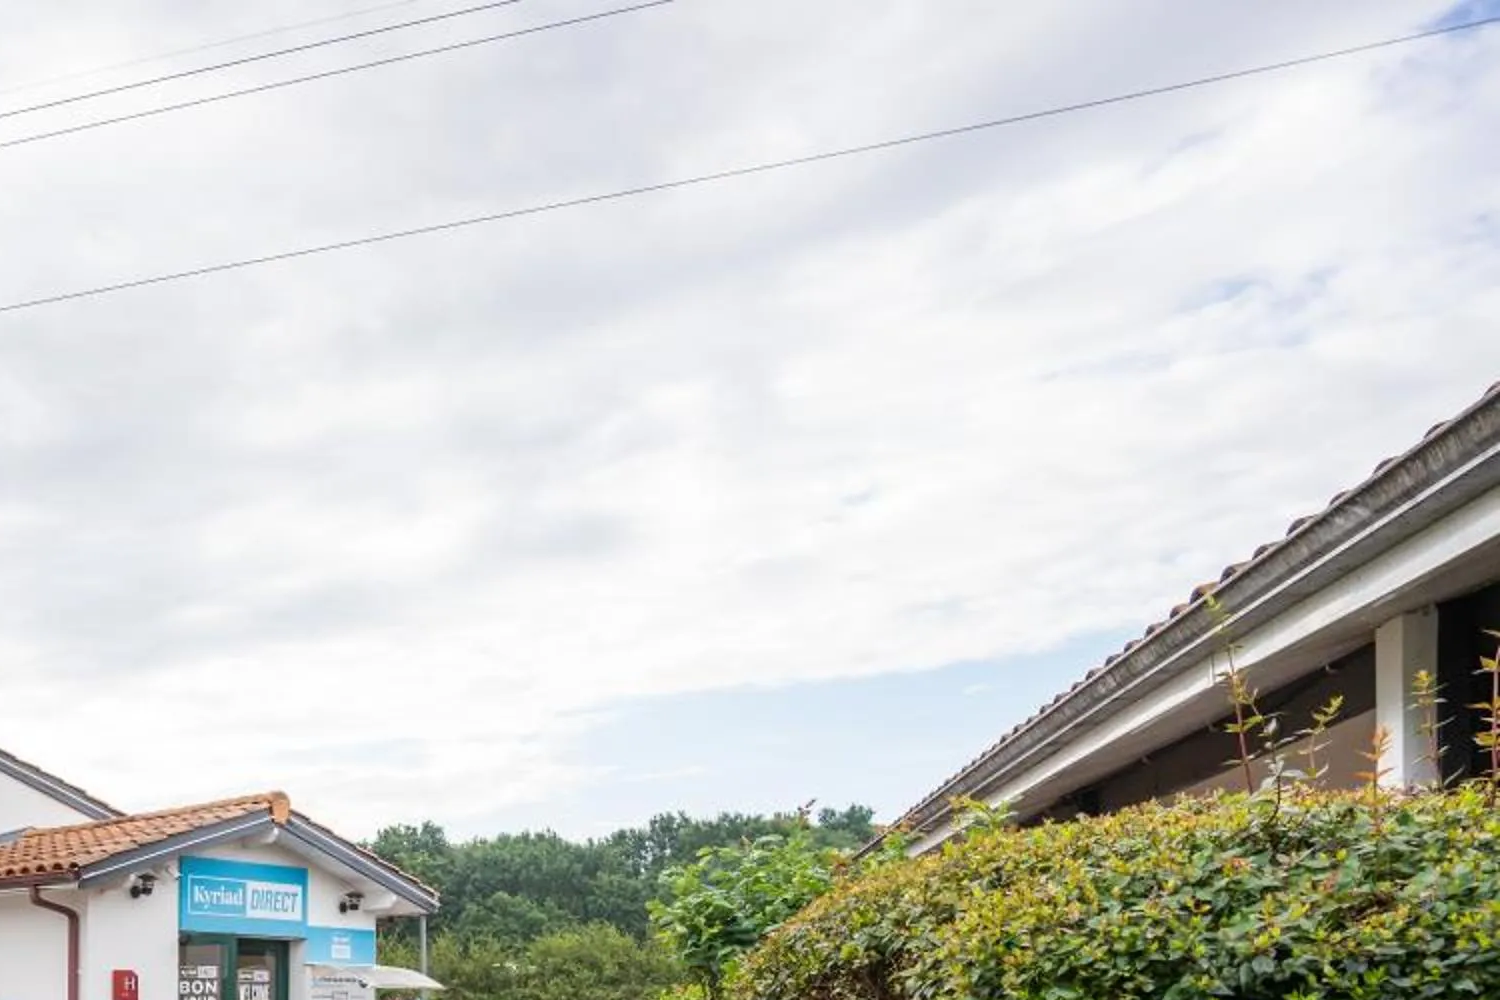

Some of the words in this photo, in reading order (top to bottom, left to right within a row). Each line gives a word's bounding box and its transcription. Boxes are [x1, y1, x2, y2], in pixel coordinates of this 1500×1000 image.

[192, 885, 244, 909] Kyriad
[250, 888, 298, 913] DIRECT
[179, 981, 218, 995] BON
